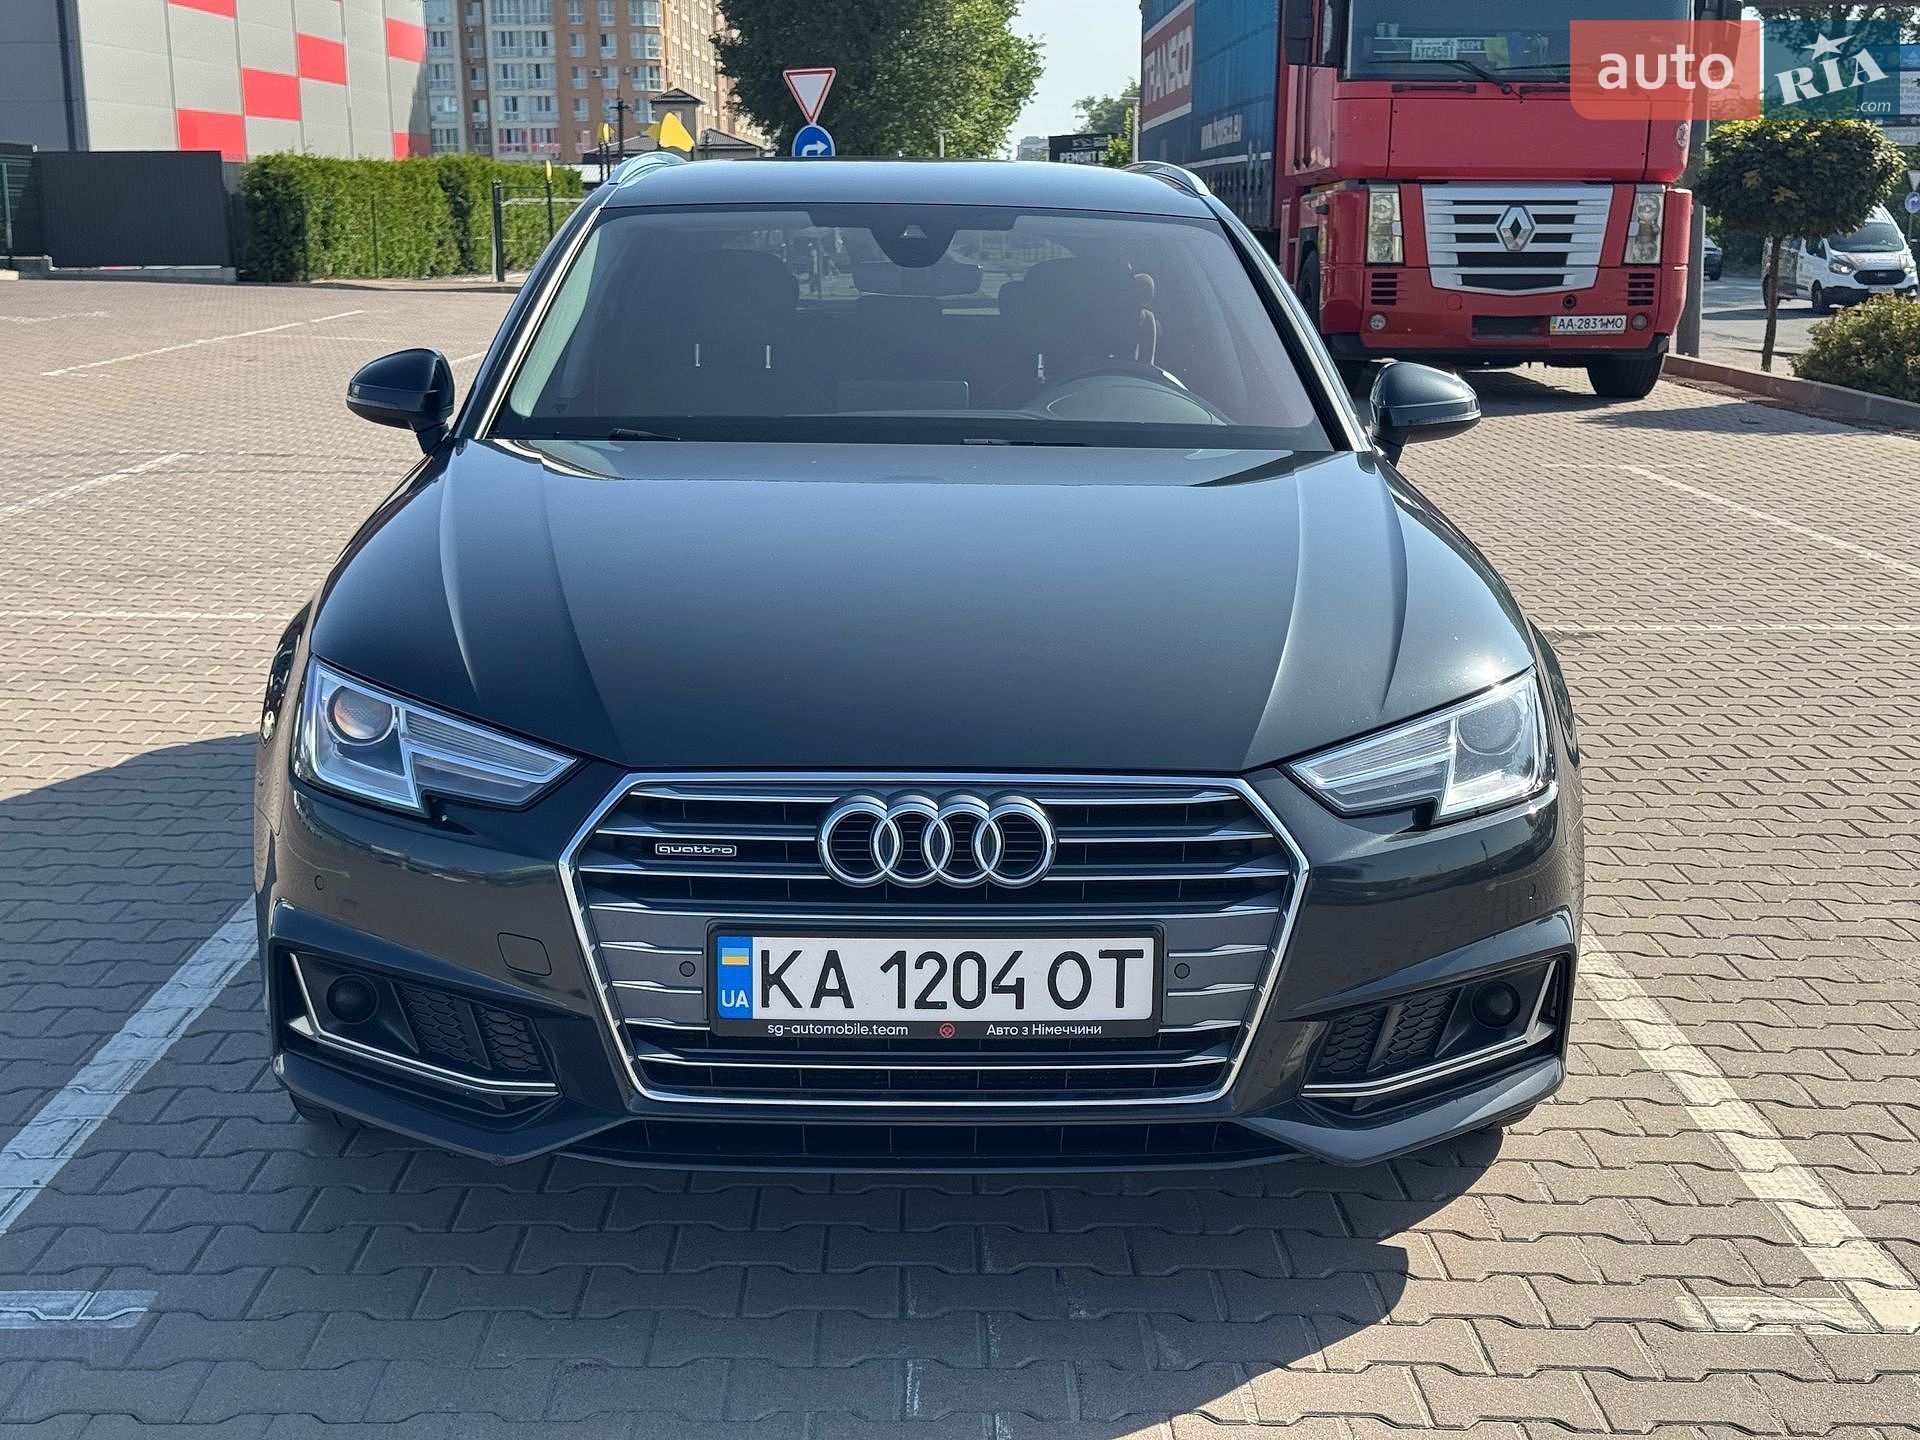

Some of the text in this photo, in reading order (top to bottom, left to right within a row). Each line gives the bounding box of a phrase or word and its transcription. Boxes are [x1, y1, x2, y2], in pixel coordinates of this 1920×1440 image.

[658, 845, 733, 855] quattro
[761, 949, 1144, 1010] KA 1204 OT
[721, 990, 749, 1008] UA
[767, 1023, 909, 1037] sg-automobile.team
[986, 1023, 1102, 1036] Авто з Німеччини
